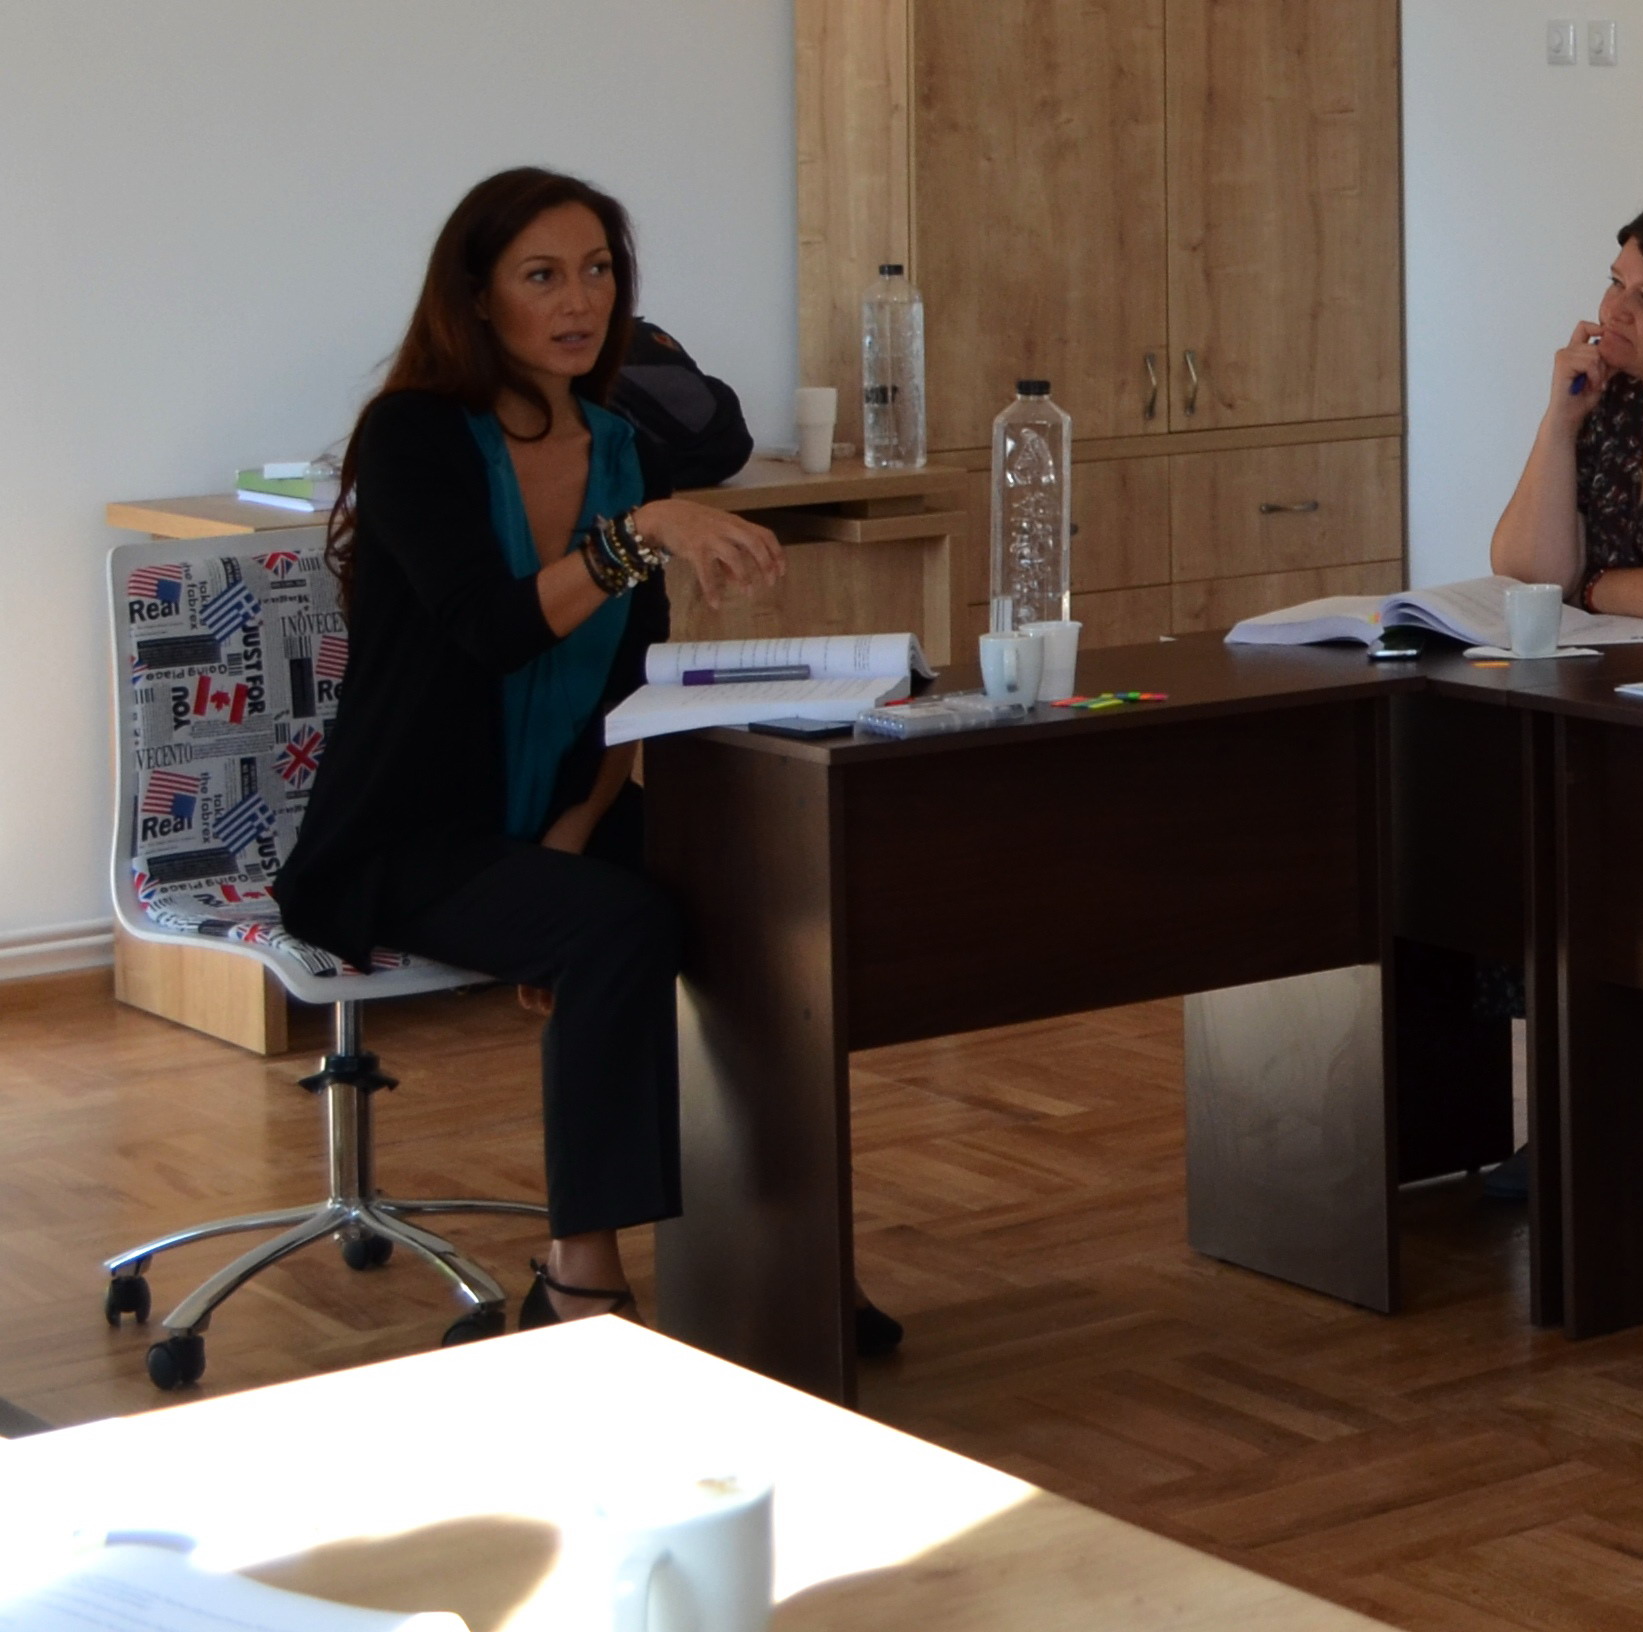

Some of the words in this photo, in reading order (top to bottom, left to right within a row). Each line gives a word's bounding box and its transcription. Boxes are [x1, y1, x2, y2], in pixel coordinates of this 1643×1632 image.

[128, 599, 180, 624] Real
[242, 624, 262, 671] JUST
[171, 687, 191, 731] YOU
[246, 674, 266, 715] FOR
[142, 816, 192, 841] Real
[201, 797, 213, 843] fabrex
